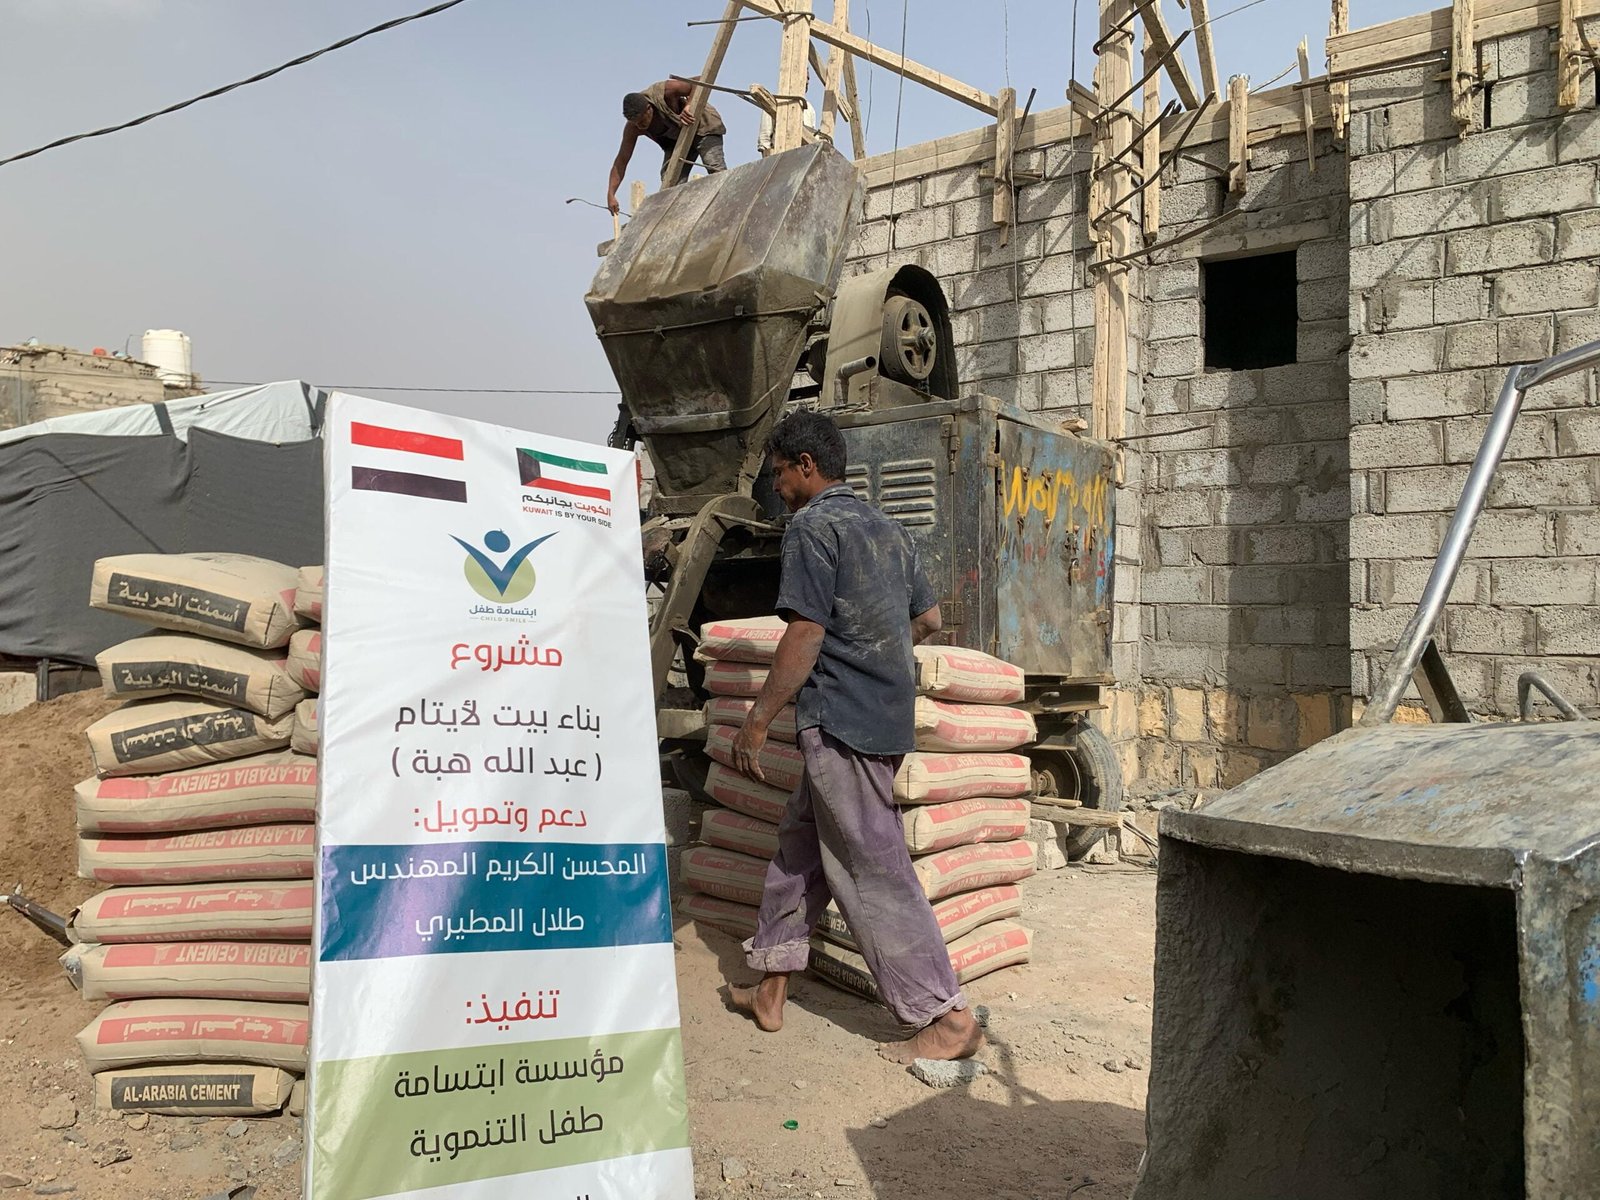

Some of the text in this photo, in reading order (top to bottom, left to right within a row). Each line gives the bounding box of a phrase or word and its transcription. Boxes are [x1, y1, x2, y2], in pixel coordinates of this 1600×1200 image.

[522, 494, 612, 517] الكويت بجانبكم
[522, 506, 553, 516] KUWAIT
[564, 511, 576, 519] BY
[576, 513, 597, 523] YOUR
[597, 518, 612, 528] SIDE
[118, 581, 241, 624] أسمنت العربية
[469, 604, 537, 618] ابتسامة طفل
[451, 634, 563, 672] مشروع
[121, 669, 239, 696] أسمنت العربية
[394, 698, 601, 738] بناء بيت لأيتام
[121, 727, 177, 758] أسمنت
[483, 747, 534, 775] الله
[167, 766, 313, 794] AL-ARABIA CEMENT
[413, 800, 588, 833] دعم وتمويل:
[165, 827, 309, 849] AL-ARABIA CEMENT
[350, 852, 647, 885] المحسن الكريم المهندس
[415, 907, 585, 942] طلال المطيري
[176, 944, 312, 964] L-ARABIA CEMENT
[465, 989, 561, 1031] تنفيذ:
[123, 1021, 186, 1041] أسمنت
[394, 1048, 625, 1099] مؤسسة ابتسامة
[123, 1084, 241, 1102] AL-ARABIA CEMENT
[410, 1106, 604, 1163] طفل التنموية
